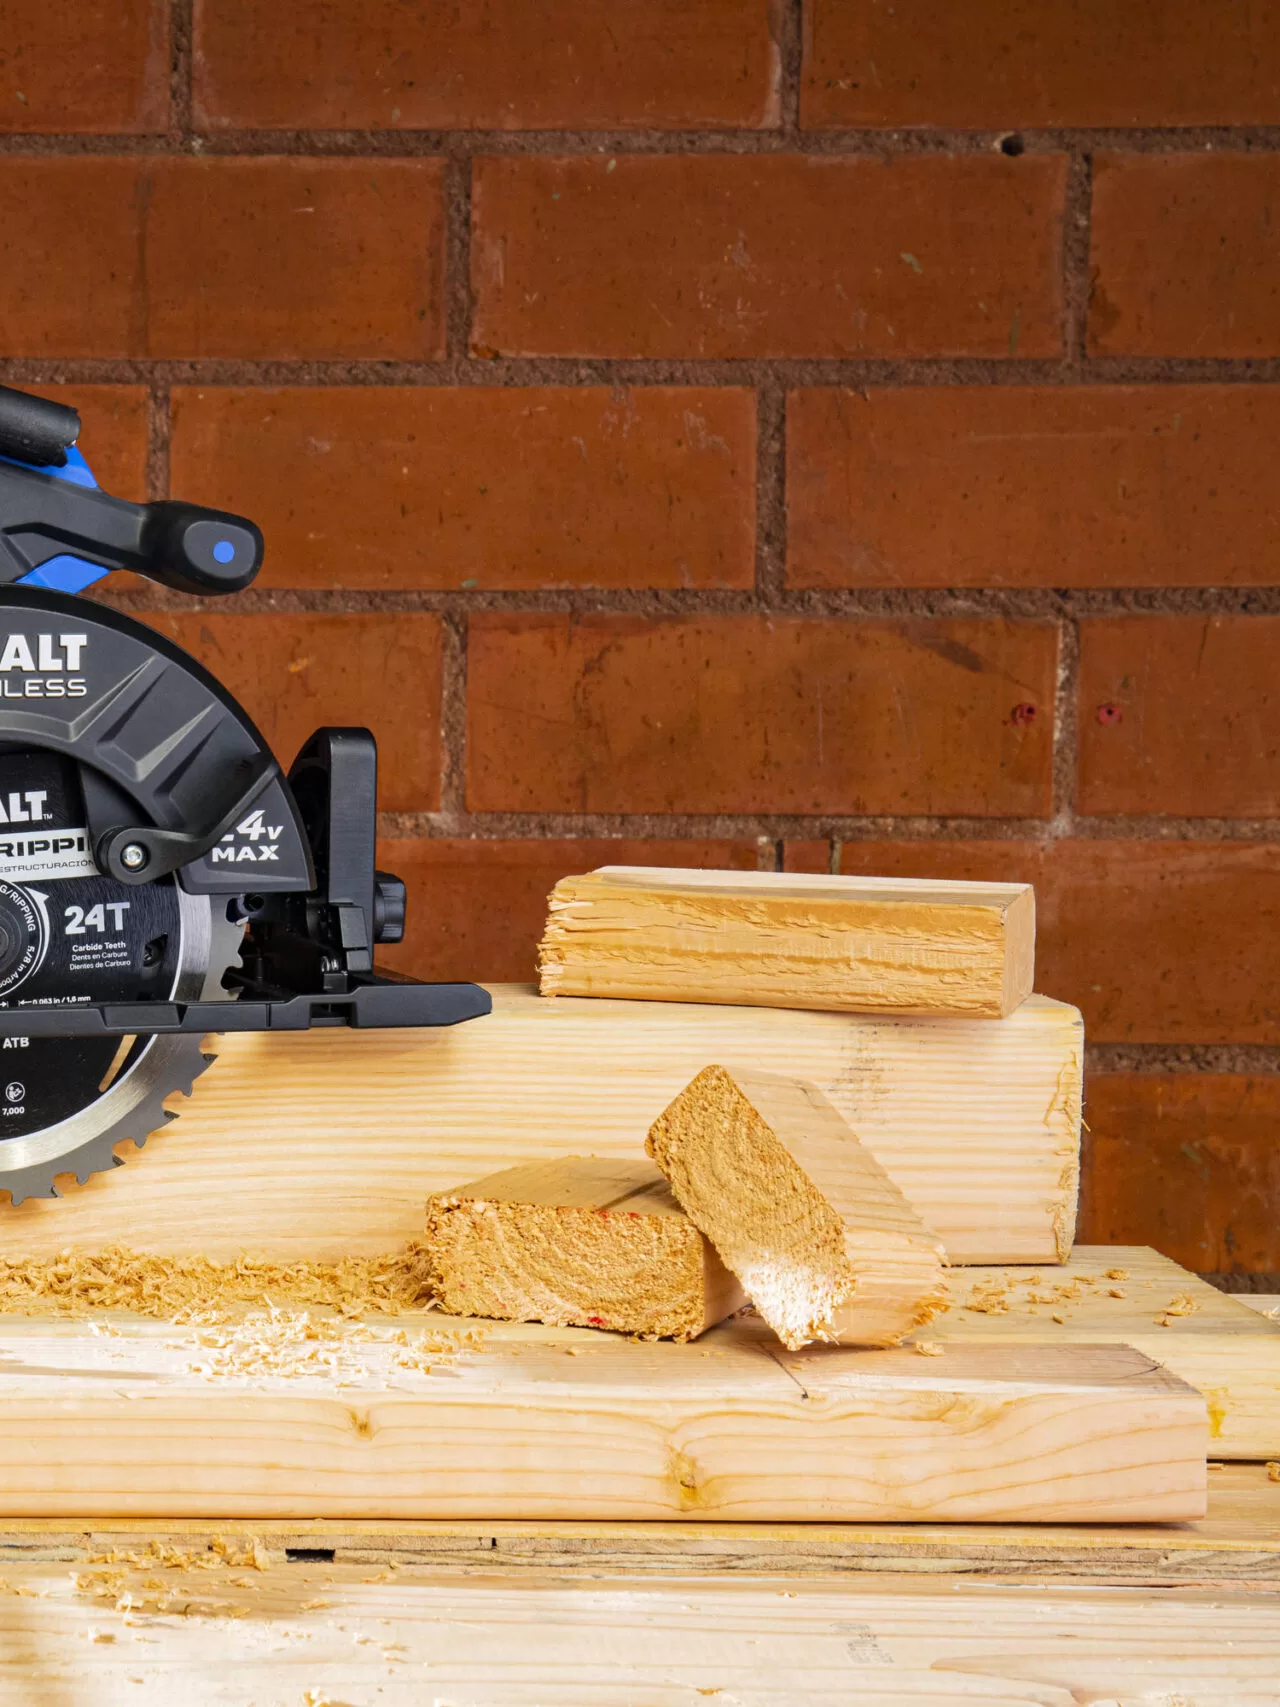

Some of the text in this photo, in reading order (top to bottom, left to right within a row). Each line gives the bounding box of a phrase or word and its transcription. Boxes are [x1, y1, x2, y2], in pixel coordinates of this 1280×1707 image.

[212, 845, 280, 862] MAX
[64, 902, 130, 935] 24T
[72, 941, 126, 952] Carbide Teeth
[2, 1037, 30, 1049] ATB
[2, 1106, 26, 1116] 7,000
